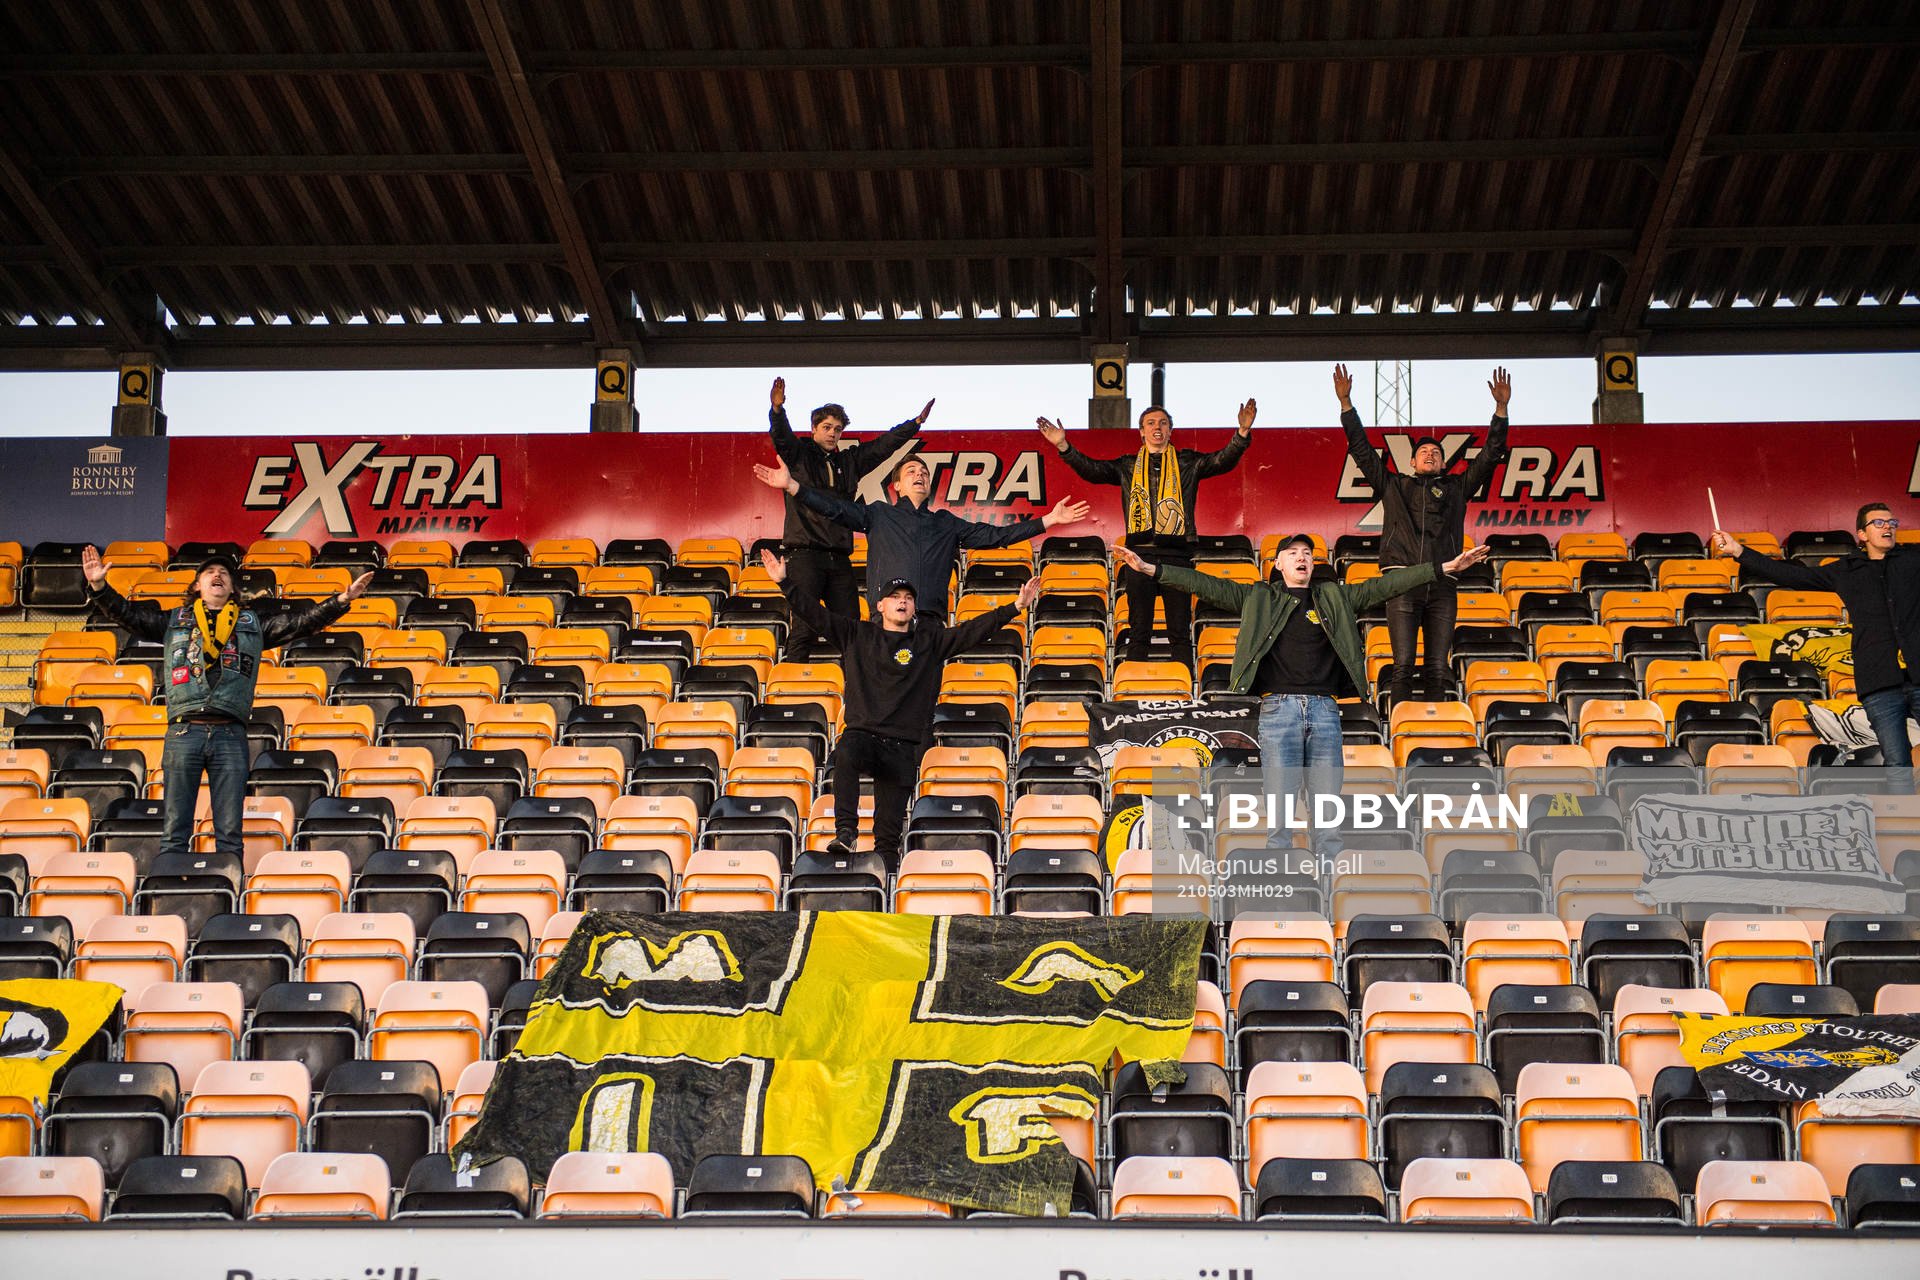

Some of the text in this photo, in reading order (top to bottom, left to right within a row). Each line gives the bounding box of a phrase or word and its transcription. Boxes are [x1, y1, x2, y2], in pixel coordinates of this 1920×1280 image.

[599, 366, 625, 395] Q
[1096, 361, 1123, 391] Q
[1606, 355, 1634, 385] Q
[122, 370, 148, 399] Q
[72, 466, 137, 476] RONNEBY
[72, 477, 135, 489] BRUNN
[243, 441, 502, 536] EXTRA
[376, 511, 490, 534] MJÄLLBY
[1475, 505, 1592, 527] MJÄLLBY
[1149, 728, 1220, 750] JÄLLBY
